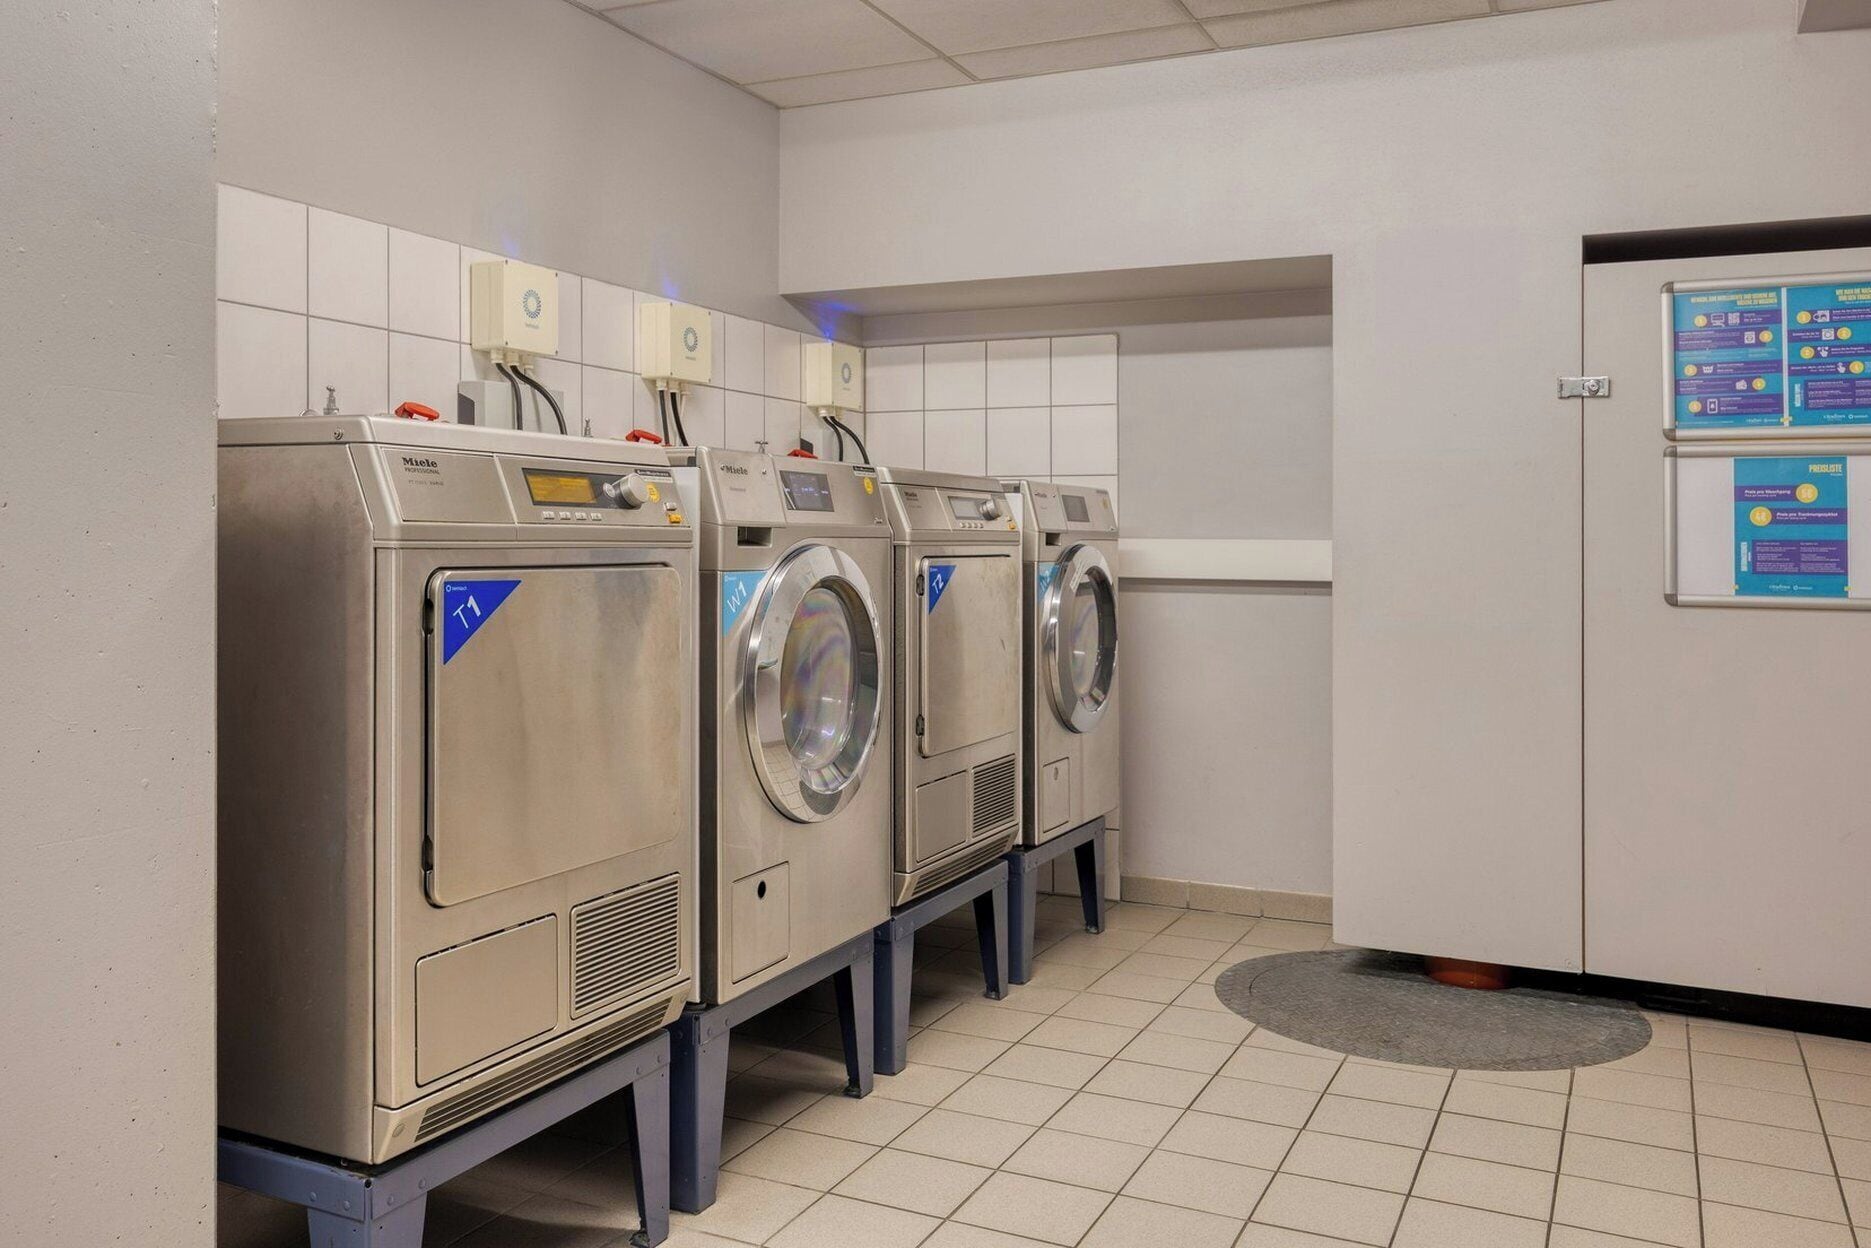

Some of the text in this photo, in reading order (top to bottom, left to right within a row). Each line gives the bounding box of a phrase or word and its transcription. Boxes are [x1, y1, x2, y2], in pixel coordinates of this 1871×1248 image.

[402, 457, 438, 468] Miele
[725, 465, 748, 475] Miele
[1808, 464, 1843, 473] PREISLISTE
[931, 573, 944, 594] T2
[727, 581, 747, 613] W1
[453, 595, 481, 629] T1
